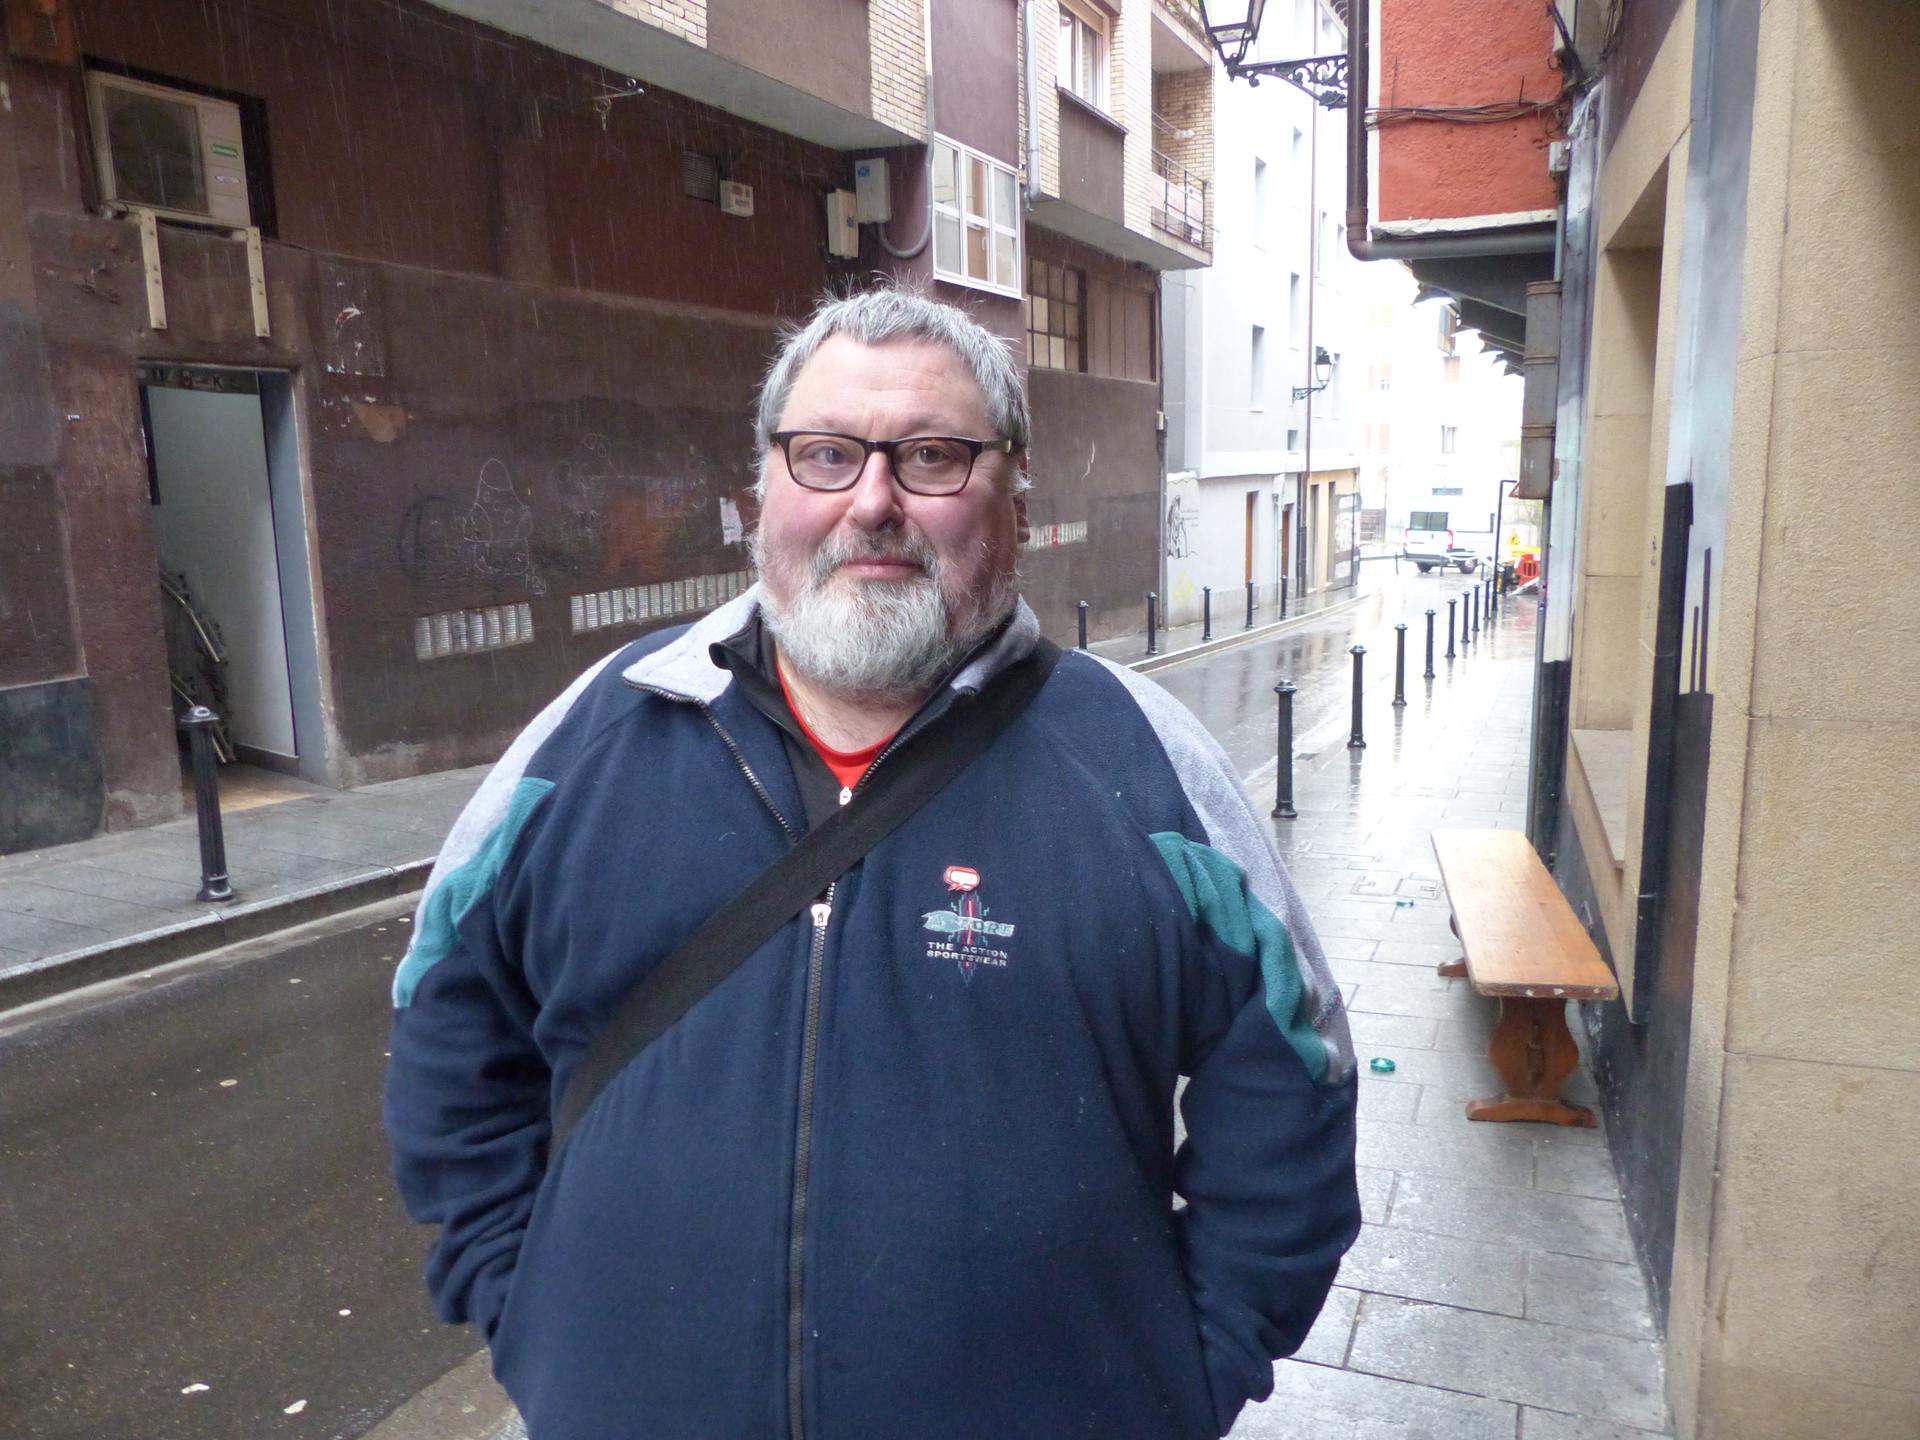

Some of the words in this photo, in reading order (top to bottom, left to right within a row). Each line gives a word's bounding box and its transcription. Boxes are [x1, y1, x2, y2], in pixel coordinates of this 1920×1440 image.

[926, 950, 1007, 967] SPORTSWEAR
[927, 942, 954, 951] THE
[962, 946, 1008, 959] ACTION
